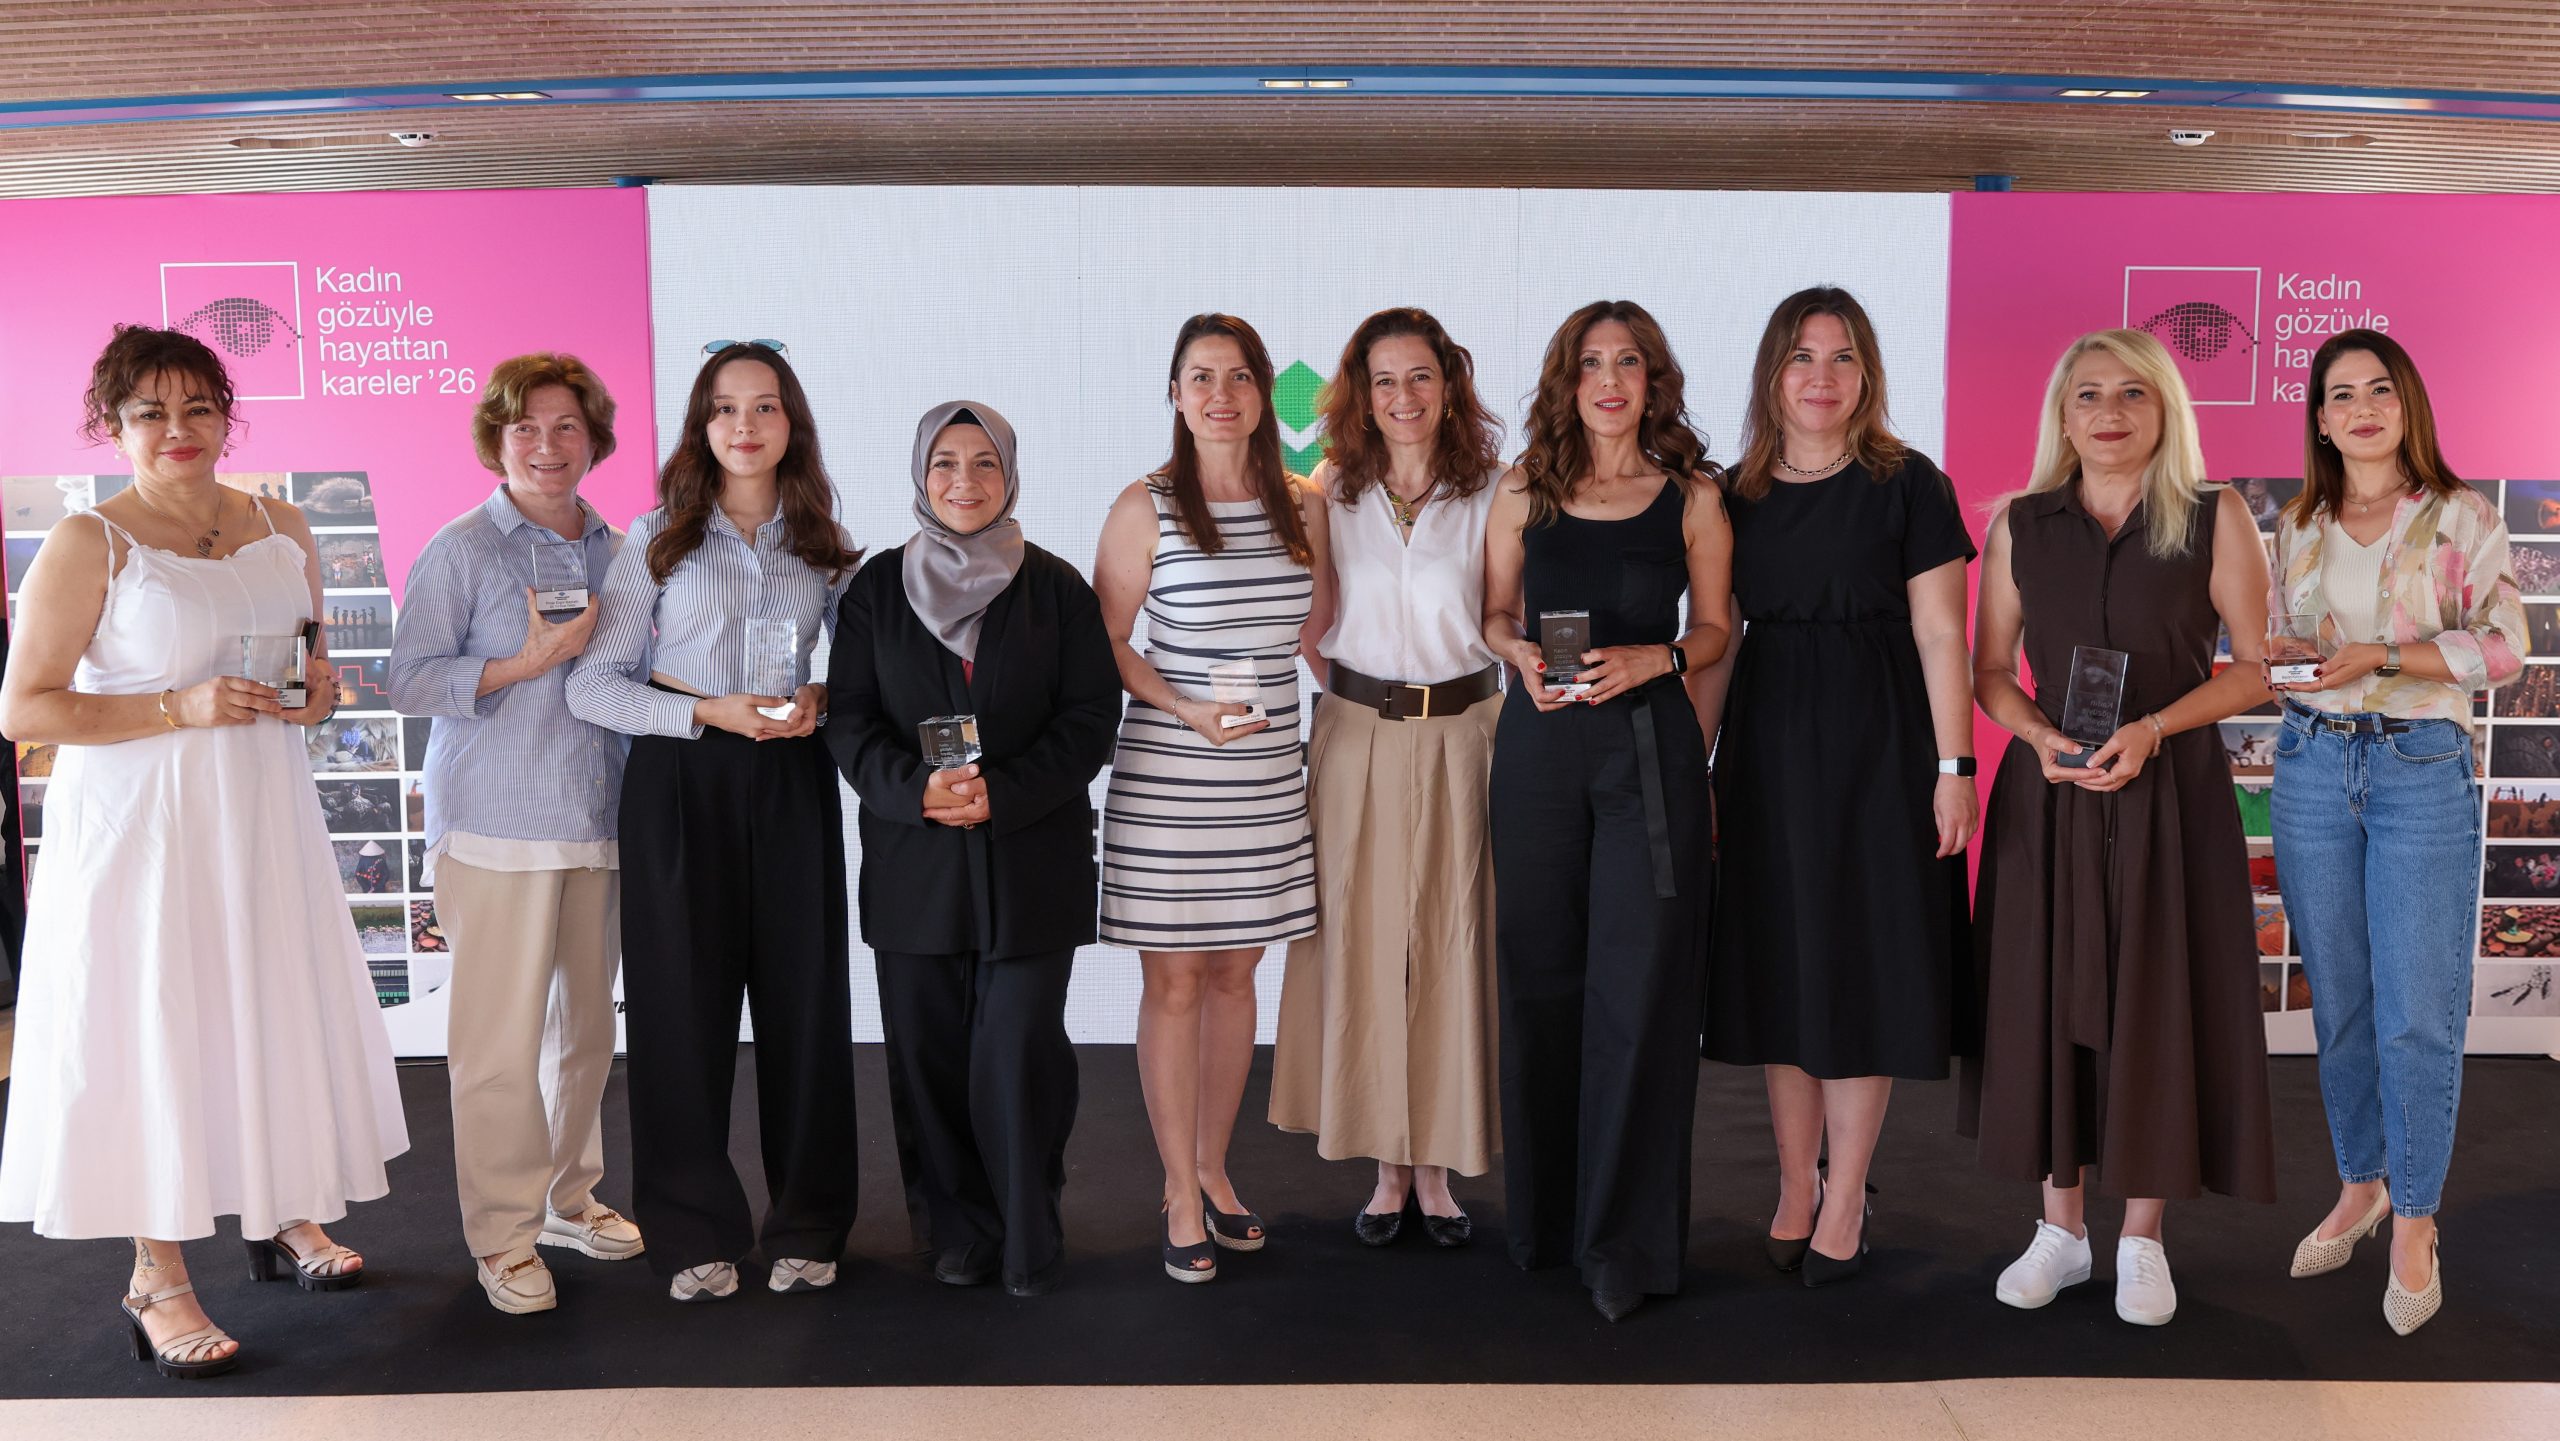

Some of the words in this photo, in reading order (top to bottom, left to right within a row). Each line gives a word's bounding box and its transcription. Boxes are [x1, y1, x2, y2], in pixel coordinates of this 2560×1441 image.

[316, 266, 402, 293] Kadın
[2277, 272, 2361, 300] Kadın
[317, 299, 434, 334] gözüyle
[319, 335, 449, 368] hayattan
[321, 368, 423, 396] kareler
